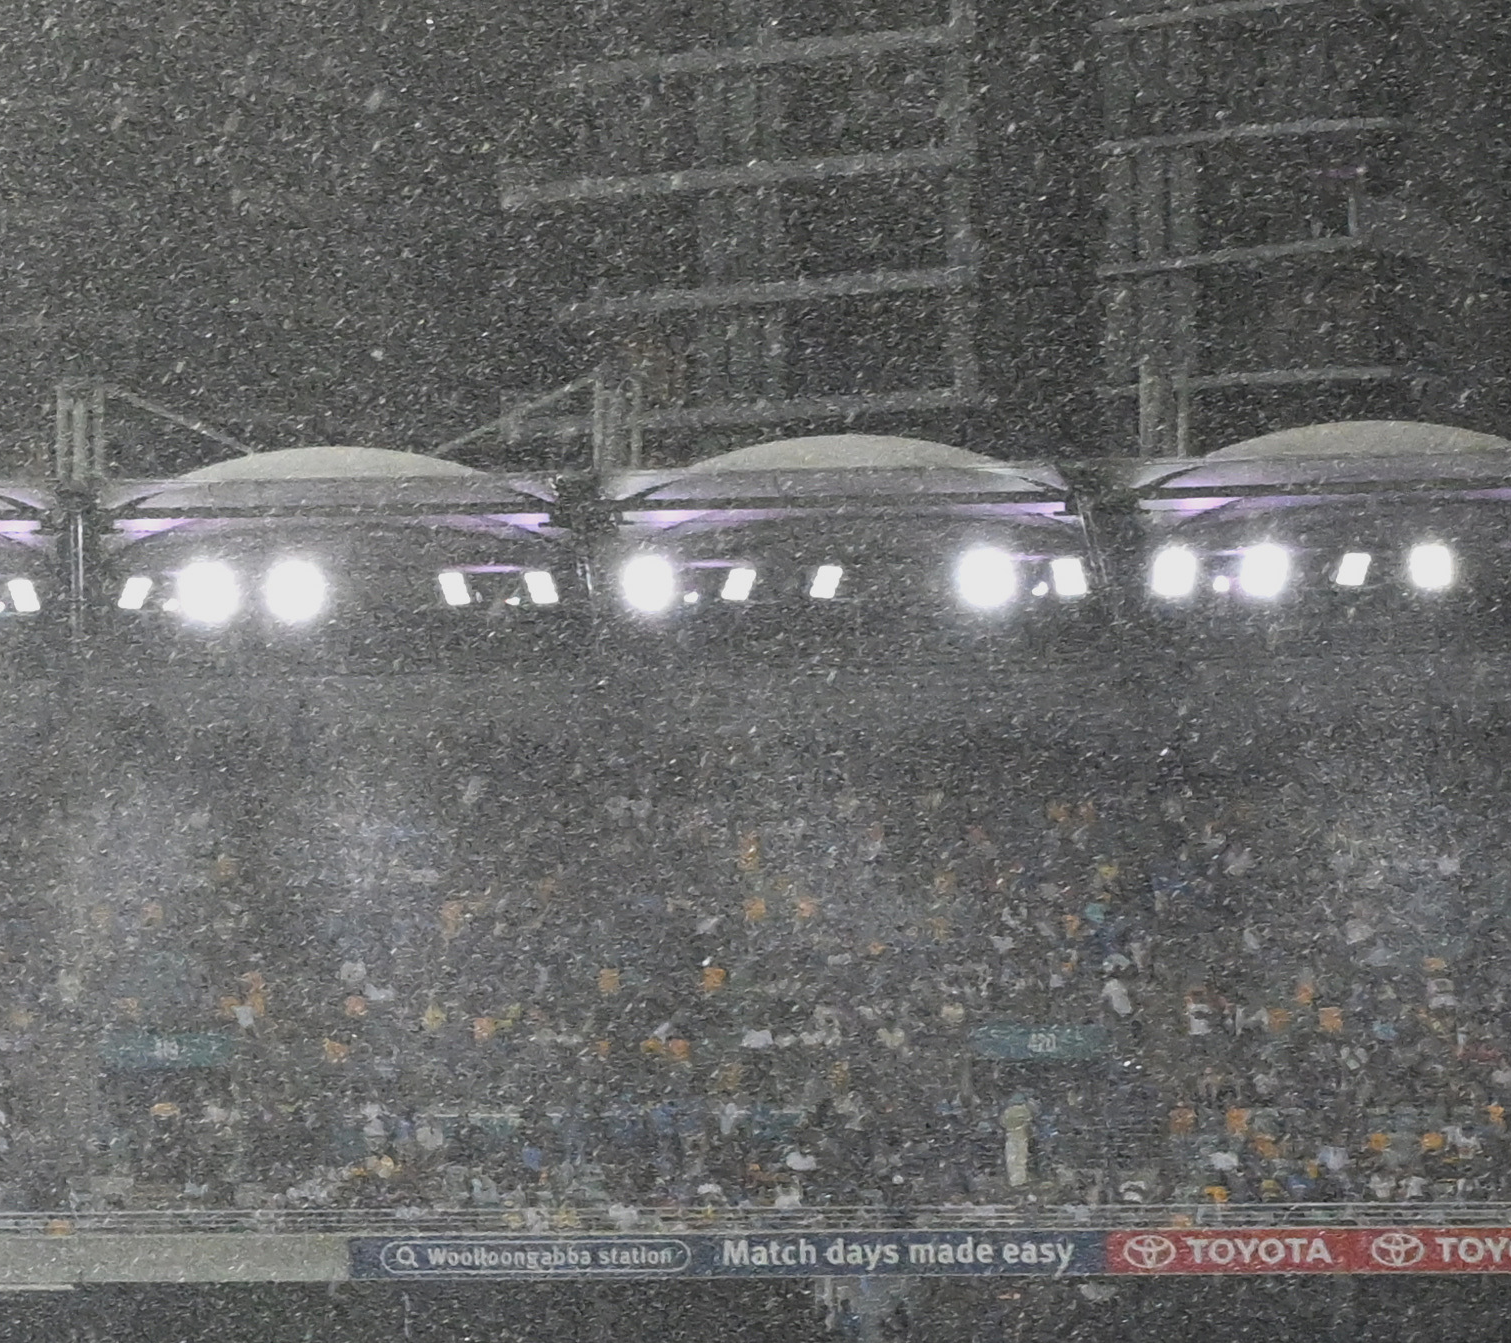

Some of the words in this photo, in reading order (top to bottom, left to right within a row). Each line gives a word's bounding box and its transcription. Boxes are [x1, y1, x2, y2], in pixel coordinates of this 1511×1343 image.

[428, 1245, 591, 1267] Woolloongabba
[596, 1247, 673, 1265] station
[722, 1239, 817, 1267] Match
[824, 1238, 900, 1272] days
[909, 1238, 993, 1265] made
[1003, 1240, 1075, 1275] easy
[1186, 1237, 1332, 1264] TOYOTA
